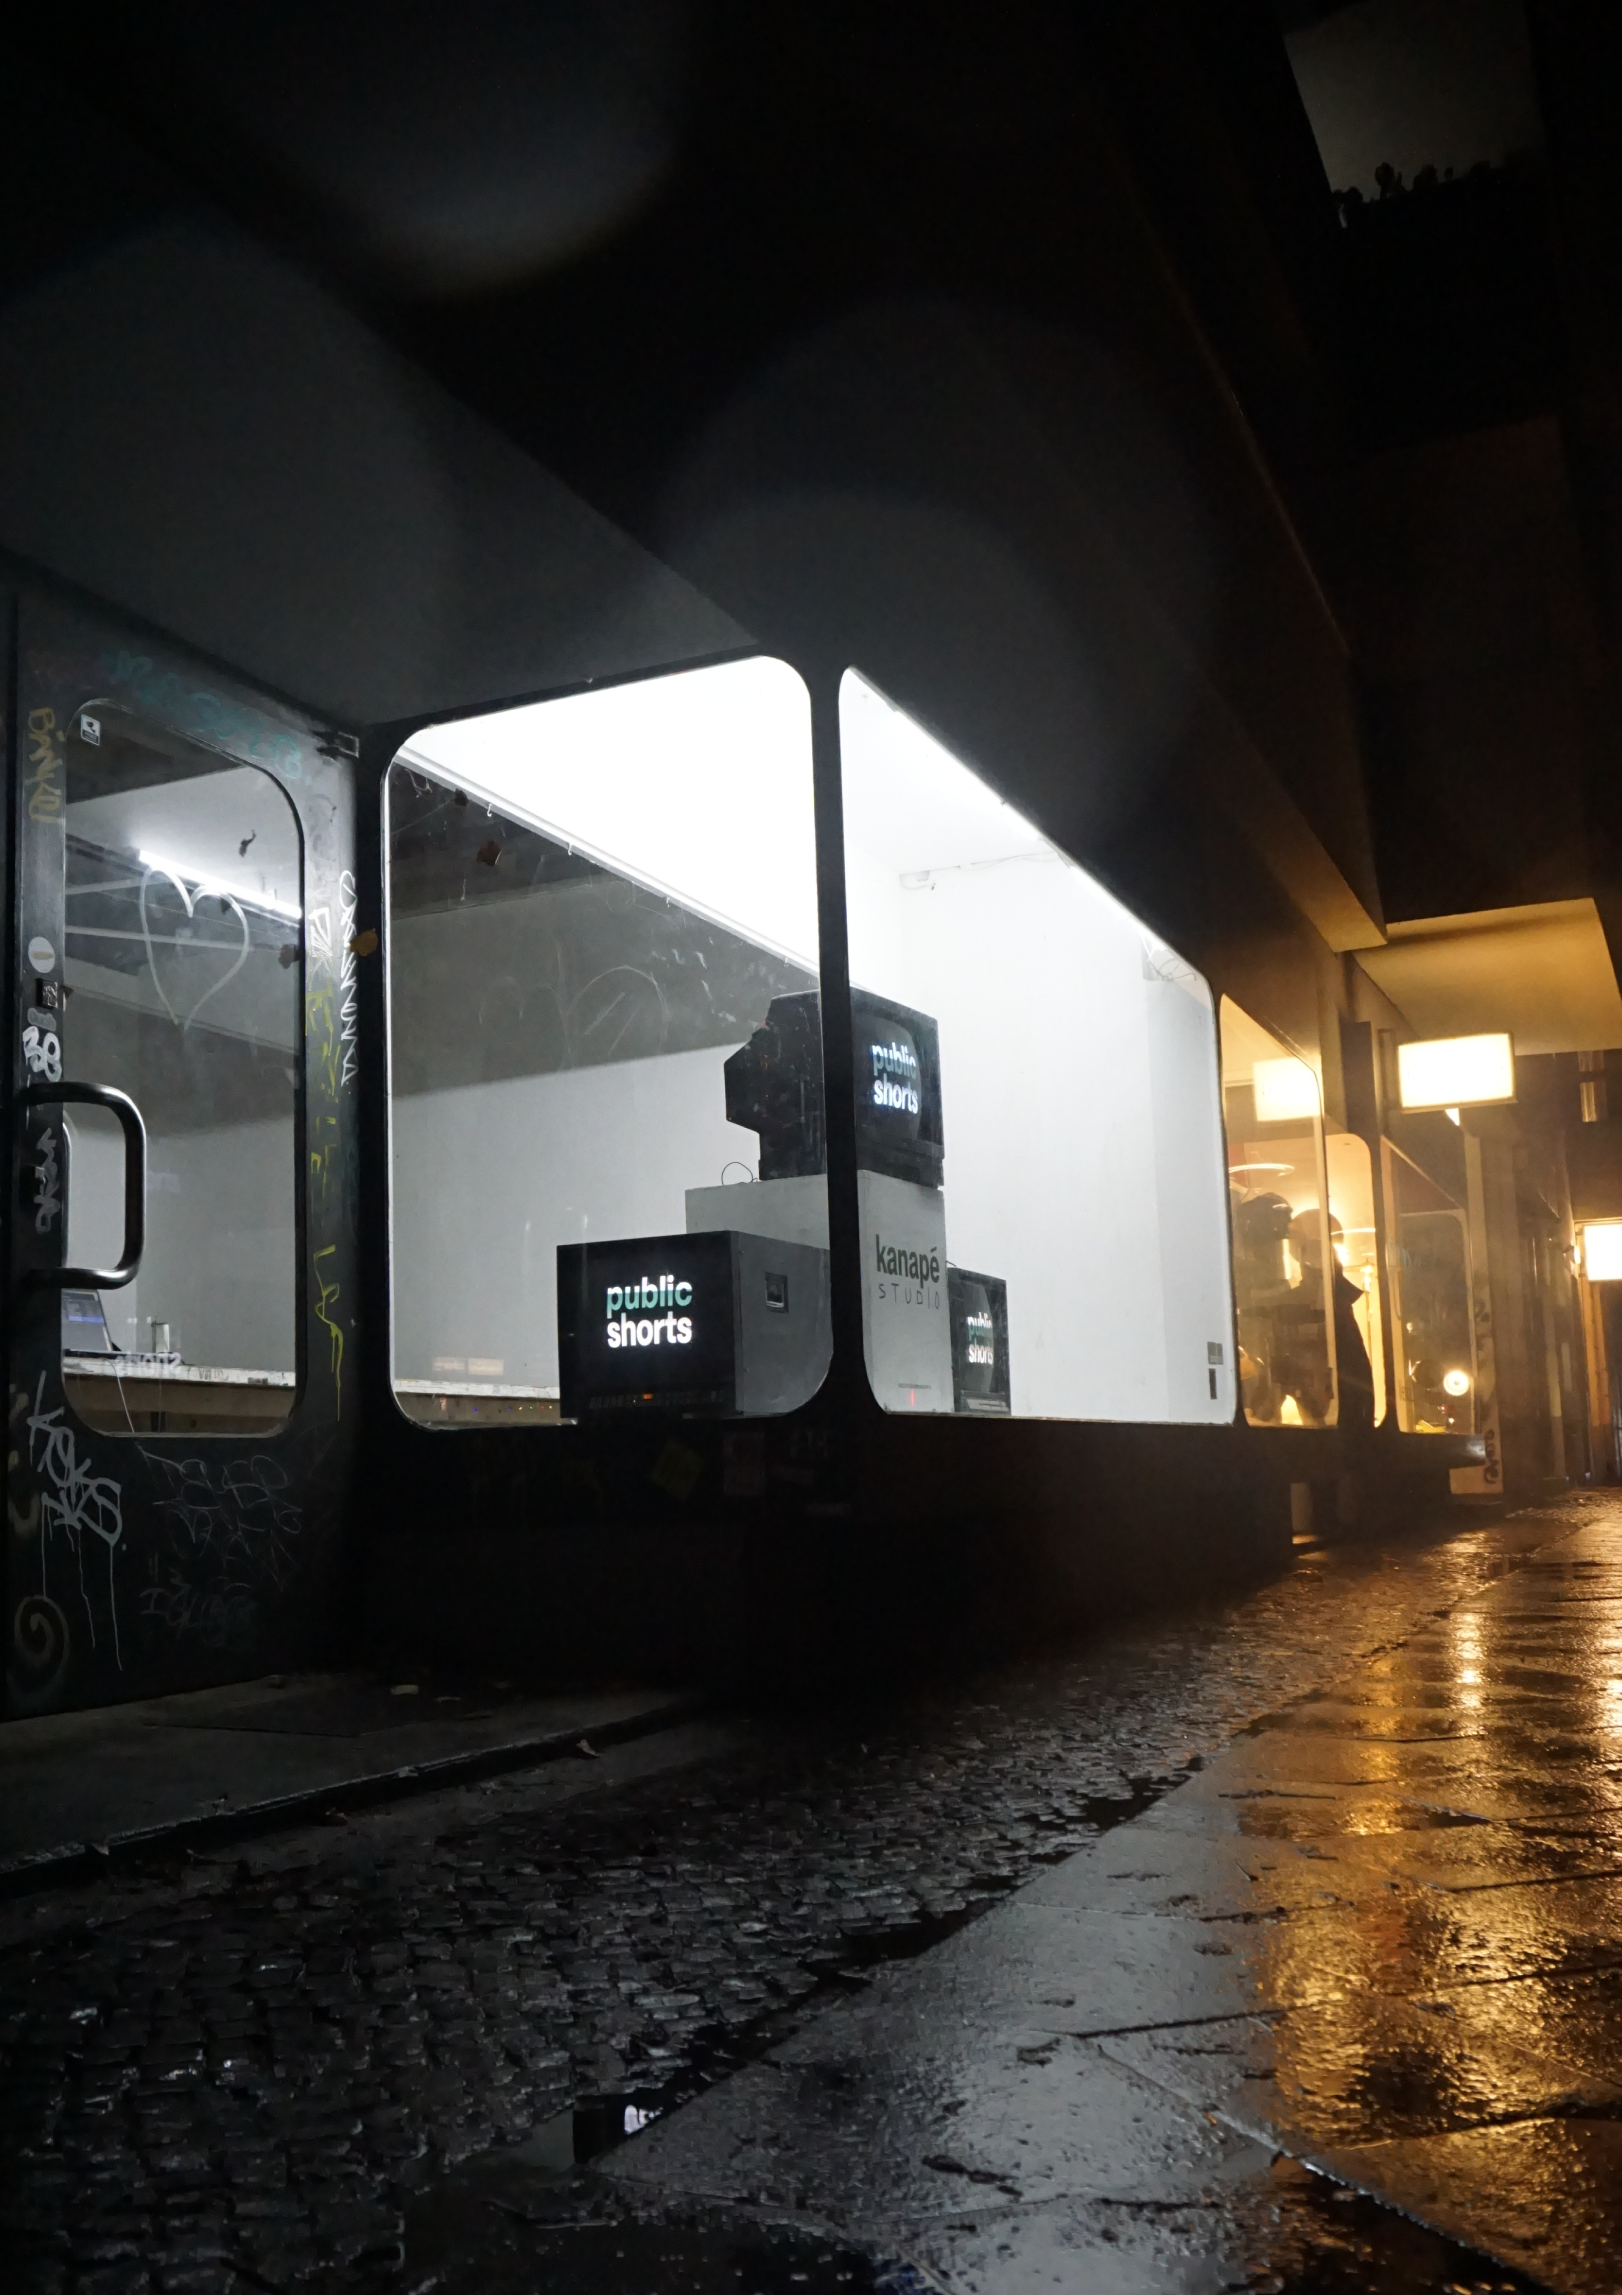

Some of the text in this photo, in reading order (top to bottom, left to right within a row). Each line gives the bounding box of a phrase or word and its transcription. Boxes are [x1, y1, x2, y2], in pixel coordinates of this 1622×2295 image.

[872, 1042, 917, 1079] public
[873, 1073, 918, 1114] shorts
[876, 1234, 940, 1289] kanapé
[607, 1275, 692, 1319] public
[879, 1283, 940, 1309] STUDIO
[607, 1311, 692, 1348] shorts
